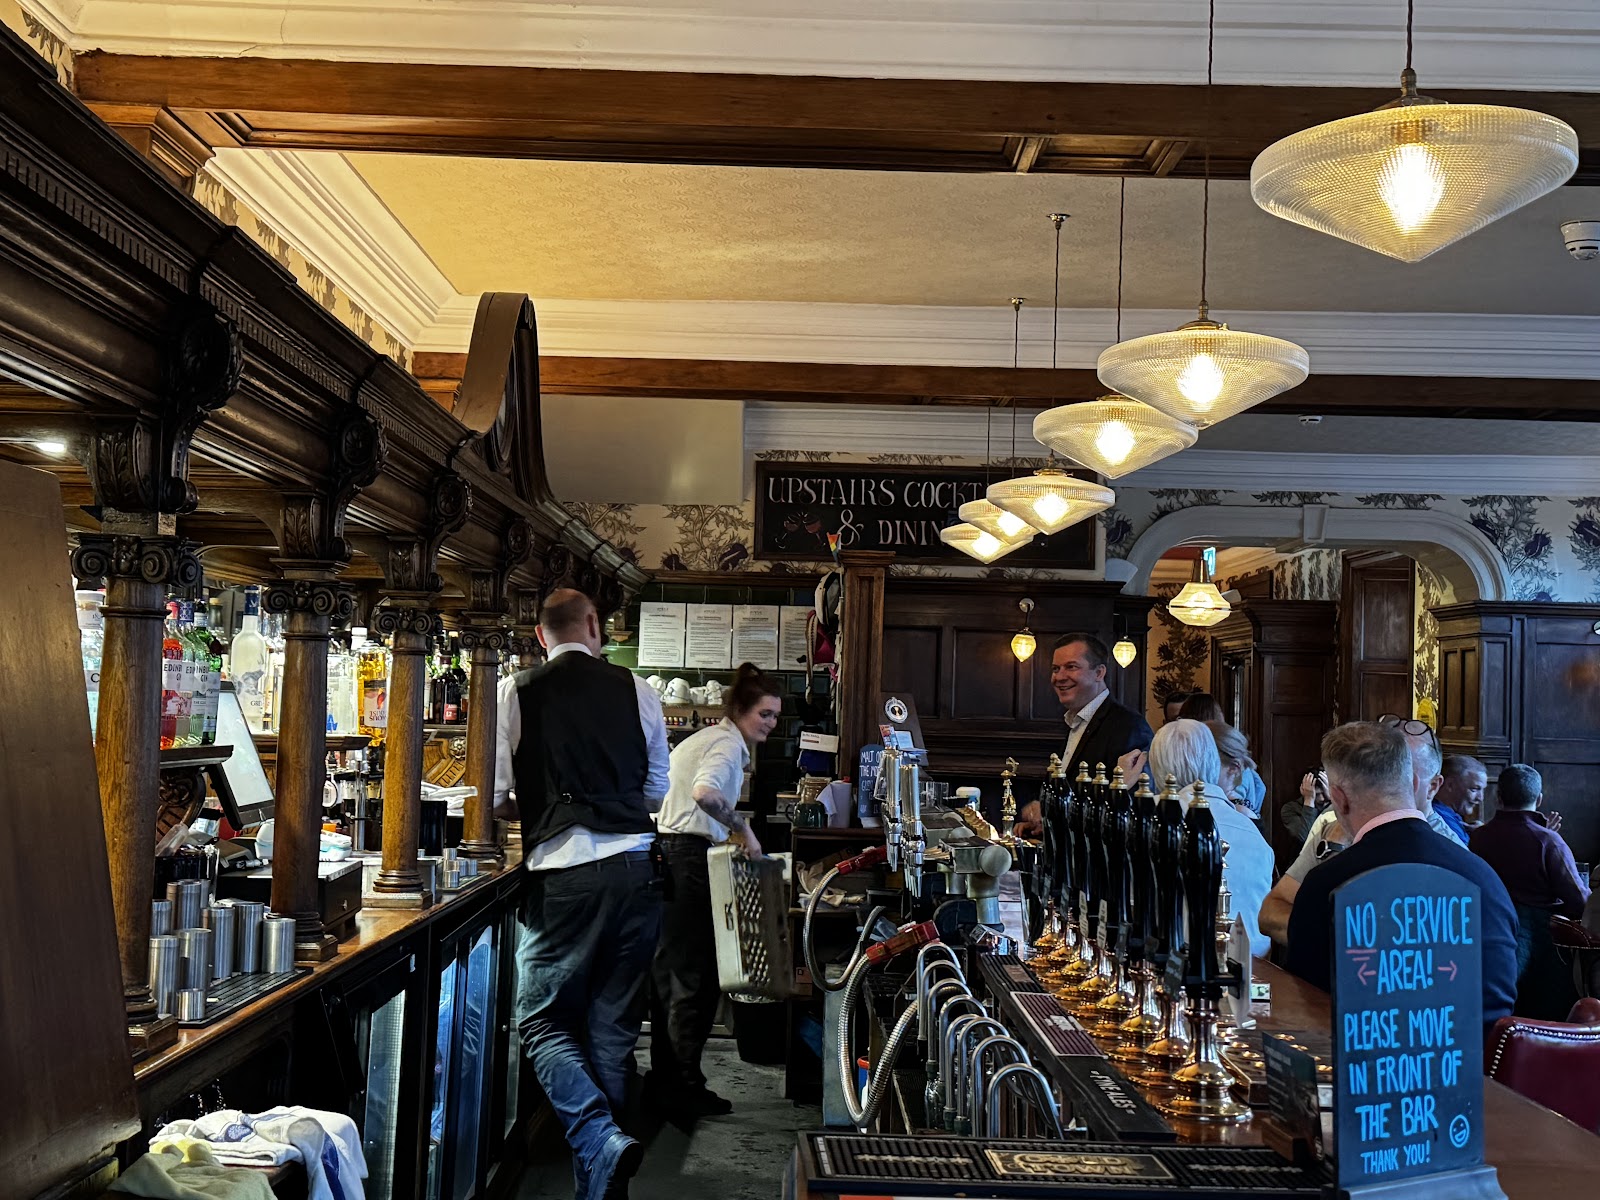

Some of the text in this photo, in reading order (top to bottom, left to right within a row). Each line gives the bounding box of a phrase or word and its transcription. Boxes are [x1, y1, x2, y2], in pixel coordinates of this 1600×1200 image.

[768, 477, 983, 508] UPSTAIRS COCKT
[837, 508, 945, 547] & DININ
[1345, 896, 1473, 948] NO SERVICE
[1377, 949, 1433, 995] AREA!
[1344, 1006, 1455, 1053] PLEASE MOVE
[1349, 1050, 1463, 1095] IN FRONT OF
[1355, 1094, 1439, 1141] THE BAR
[1360, 1140, 1431, 1174] THANK YOU!
